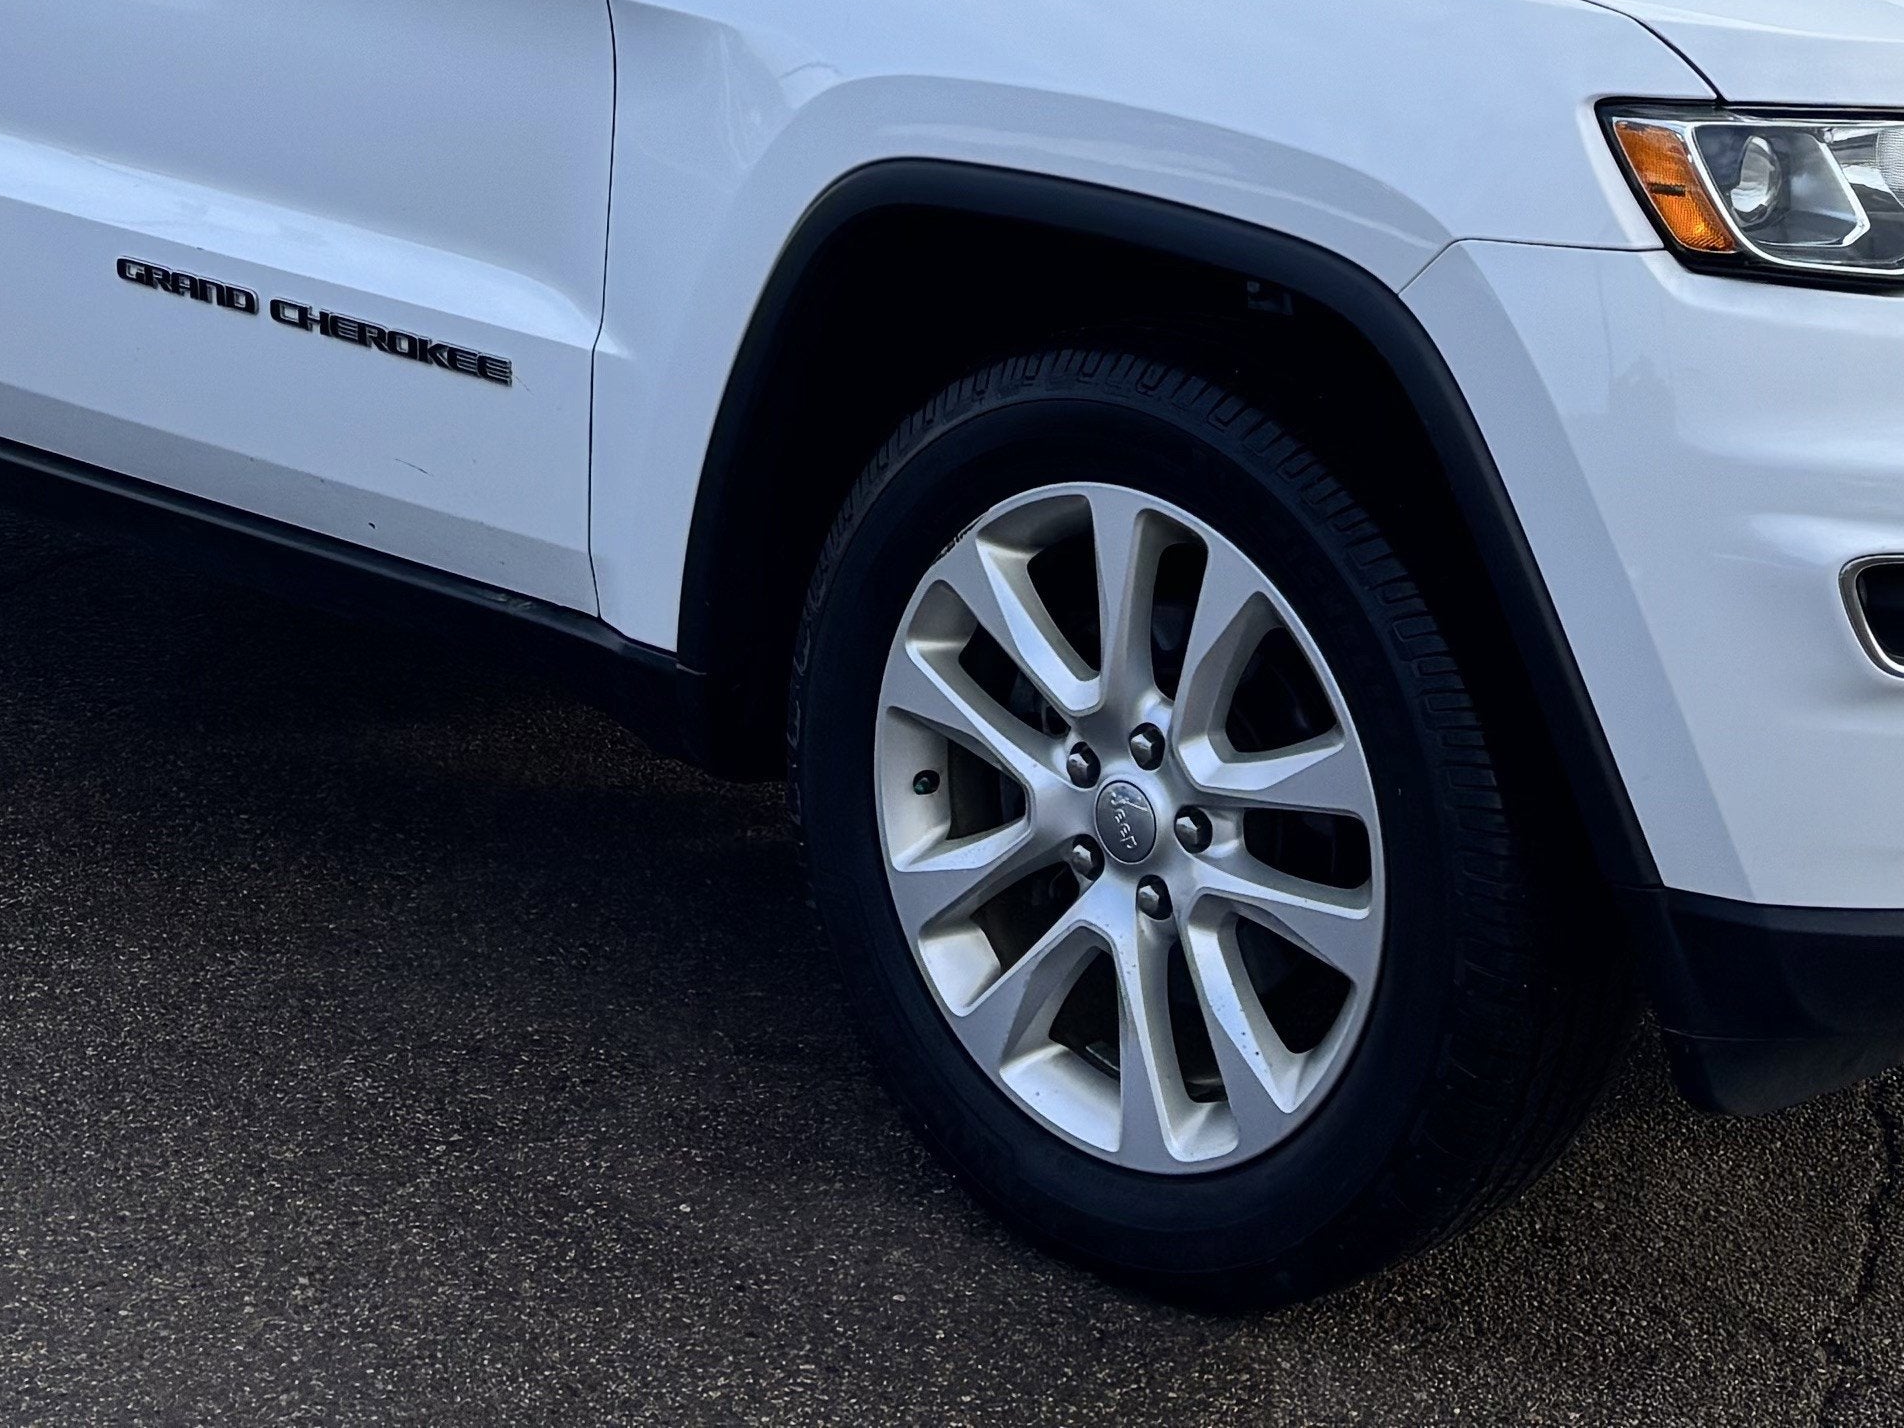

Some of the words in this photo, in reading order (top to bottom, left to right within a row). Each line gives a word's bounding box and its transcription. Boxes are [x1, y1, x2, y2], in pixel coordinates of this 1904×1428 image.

[115, 254, 260, 315] GRAND
[269, 296, 514, 388] CHEROKEE
[1109, 790, 1149, 850] Jeep
